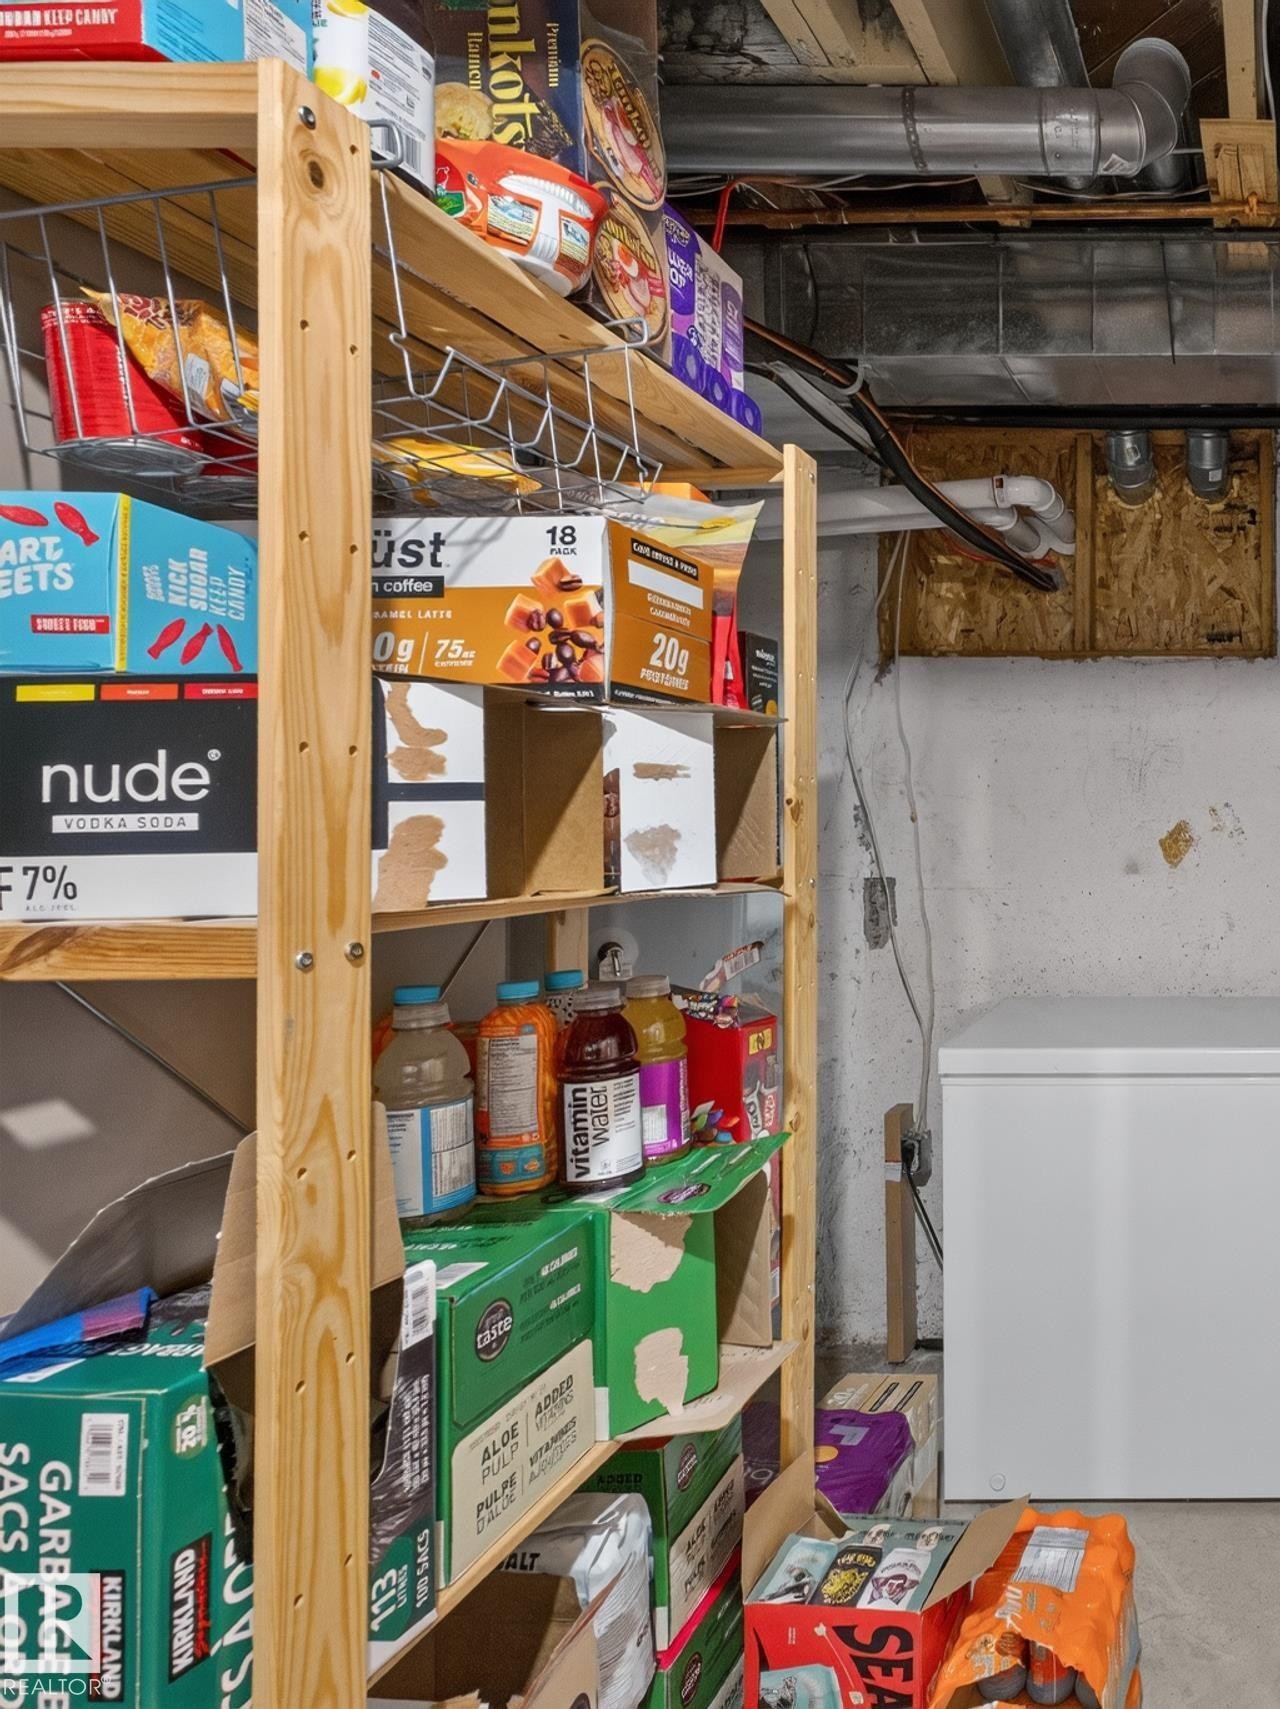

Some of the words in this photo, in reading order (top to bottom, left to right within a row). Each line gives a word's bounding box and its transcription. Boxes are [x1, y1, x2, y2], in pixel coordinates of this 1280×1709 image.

[546, 525, 577, 546] 18
[383, 578, 433, 593] coffee
[418, 610, 453, 619] LATTE
[650, 632, 689, 676] 20g
[42, 749, 211, 803] nude
[64, 817, 128, 830] VODKA
[137, 816, 187, 829] SODA
[22, 865, 78, 901] 7%
[569, 1086, 590, 1179] vitamin
[591, 1085, 609, 1148] water
[477, 1315, 512, 1350] taste
[535, 1374, 574, 1418] ADDED
[481, 1421, 519, 1466] ALOE
[482, 1441, 519, 1485] PULP
[476, 1471, 517, 1519] PULPE
[37, 1461, 73, 1675] GARBAGE
[416, 1527, 431, 1572] SACS
[172, 1548, 196, 1675] KIRKLAND
[370, 1568, 398, 1634] 113
[415, 1576, 430, 1608] 100
[102, 1575, 123, 1699] KIRKLAND
